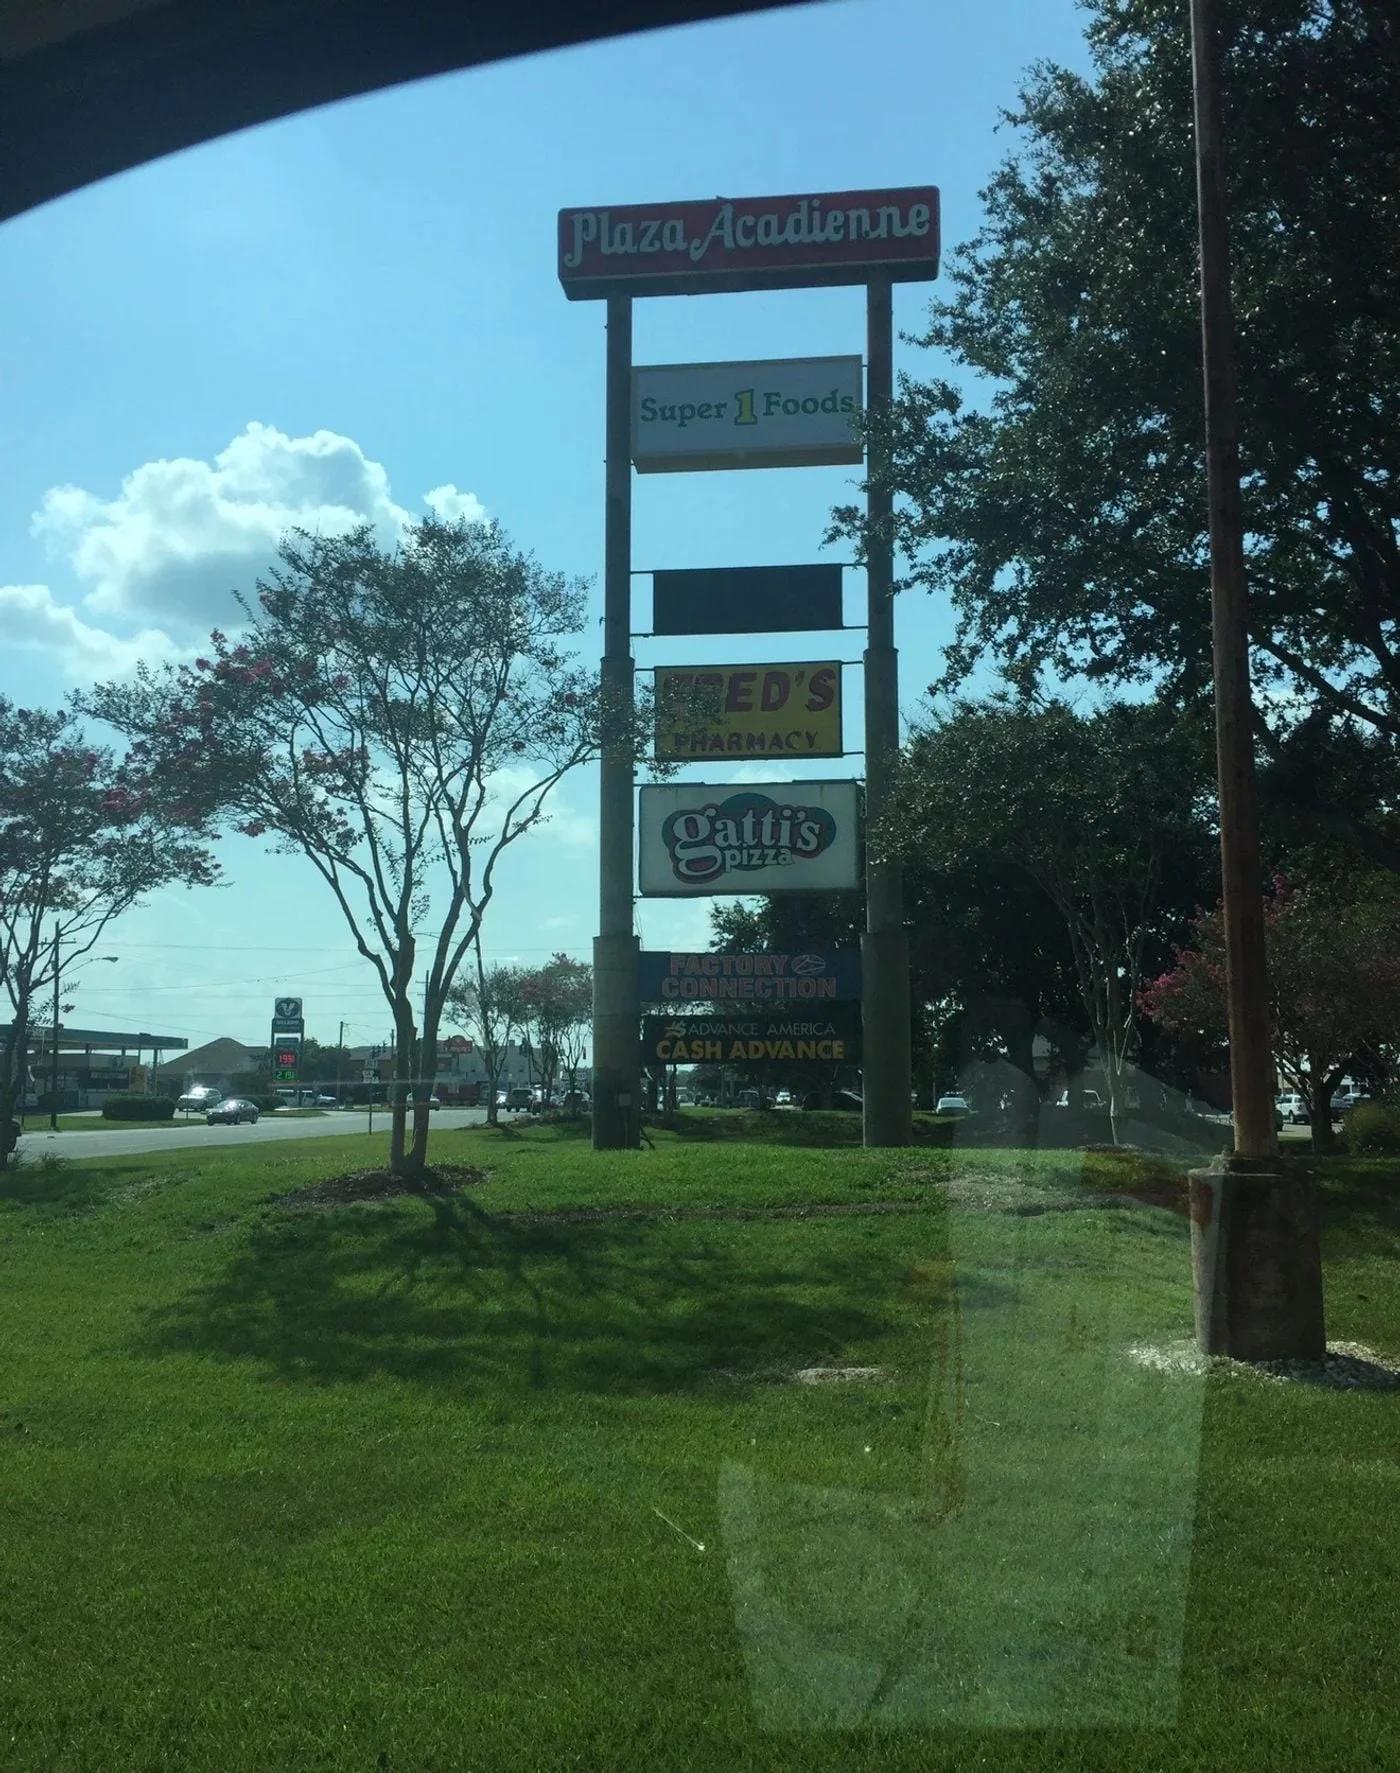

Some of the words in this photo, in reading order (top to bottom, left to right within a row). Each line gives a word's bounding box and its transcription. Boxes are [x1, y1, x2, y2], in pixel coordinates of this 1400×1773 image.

[564, 211, 688, 268] Plaza
[688, 199, 931, 262] Acadienne
[640, 396, 728, 428] Super
[733, 389, 758, 425] 1
[763, 388, 853, 417] Foods
[663, 668, 837, 713] ED'S
[674, 730, 818, 752] PHARMACY
[671, 805, 821, 876] gatti's
[724, 845, 795, 872] pizza
[669, 954, 789, 976] FACTORY
[661, 977, 837, 998] CONNECTION
[687, 1023, 759, 1036] ADVANCE
[766, 1022, 836, 1035] AMERICA
[655, 1040, 722, 1060] CASH
[729, 1039, 845, 1060] ADVANCE
